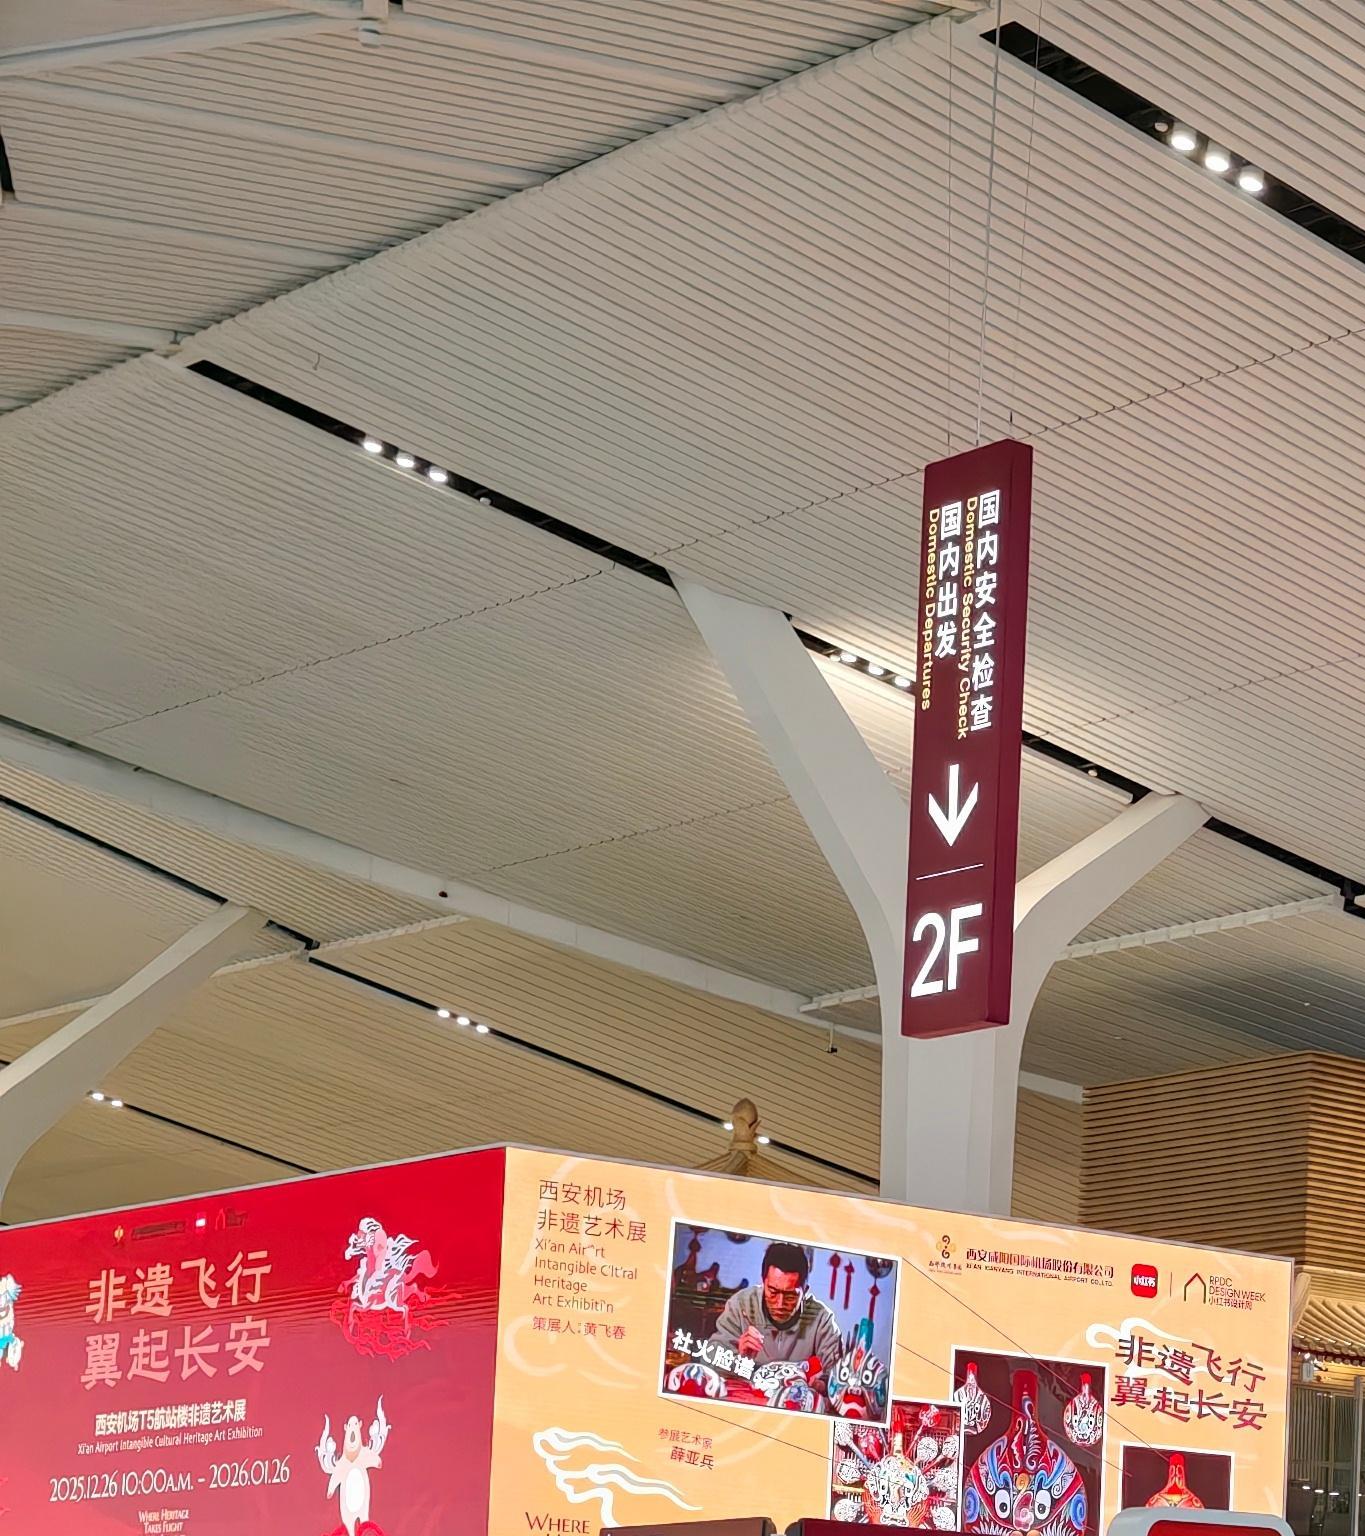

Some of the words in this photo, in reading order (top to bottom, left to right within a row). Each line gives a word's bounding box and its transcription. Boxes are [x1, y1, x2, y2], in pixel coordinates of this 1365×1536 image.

[926, 508, 940, 599] Domestic
[963, 497, 978, 587] Domestic
[934, 501, 962, 659] 国内出发
[958, 594, 973, 672] Security
[970, 489, 1000, 731] 国内安全检查
[922, 602, 936, 711] Departures
[957, 677, 970, 740] Check
[910, 902, 983, 998] 2F
[539, 1179, 626, 1211] 西安机场
[535, 1238, 565, 1254] Xi'an
[537, 1208, 647, 1243] 非遗艺术展
[85, 1250, 272, 1323] 非遗飞行
[534, 1274, 588, 1295] Heritage
[535, 1256, 597, 1276] Intangible
[532, 1292, 552, 1307] Art
[80, 1315, 271, 1391] 翼起长安
[672, 1328, 756, 1380] 社火脸谱
[1115, 1334, 1266, 1393] 非遗飞行
[95, 1398, 247, 1437] 西安机场T5航站楼非遗艺术展
[1111, 1374, 1267, 1431] 翼起长安
[95, 1440, 118, 1455] Airport
[154, 1434, 182, 1448] Cultural
[183, 1431, 213, 1446] Heritage
[214, 1429, 225, 1442] Art
[227, 1426, 263, 1441] Exhibition
[525, 1511, 590, 1534] WHERE
